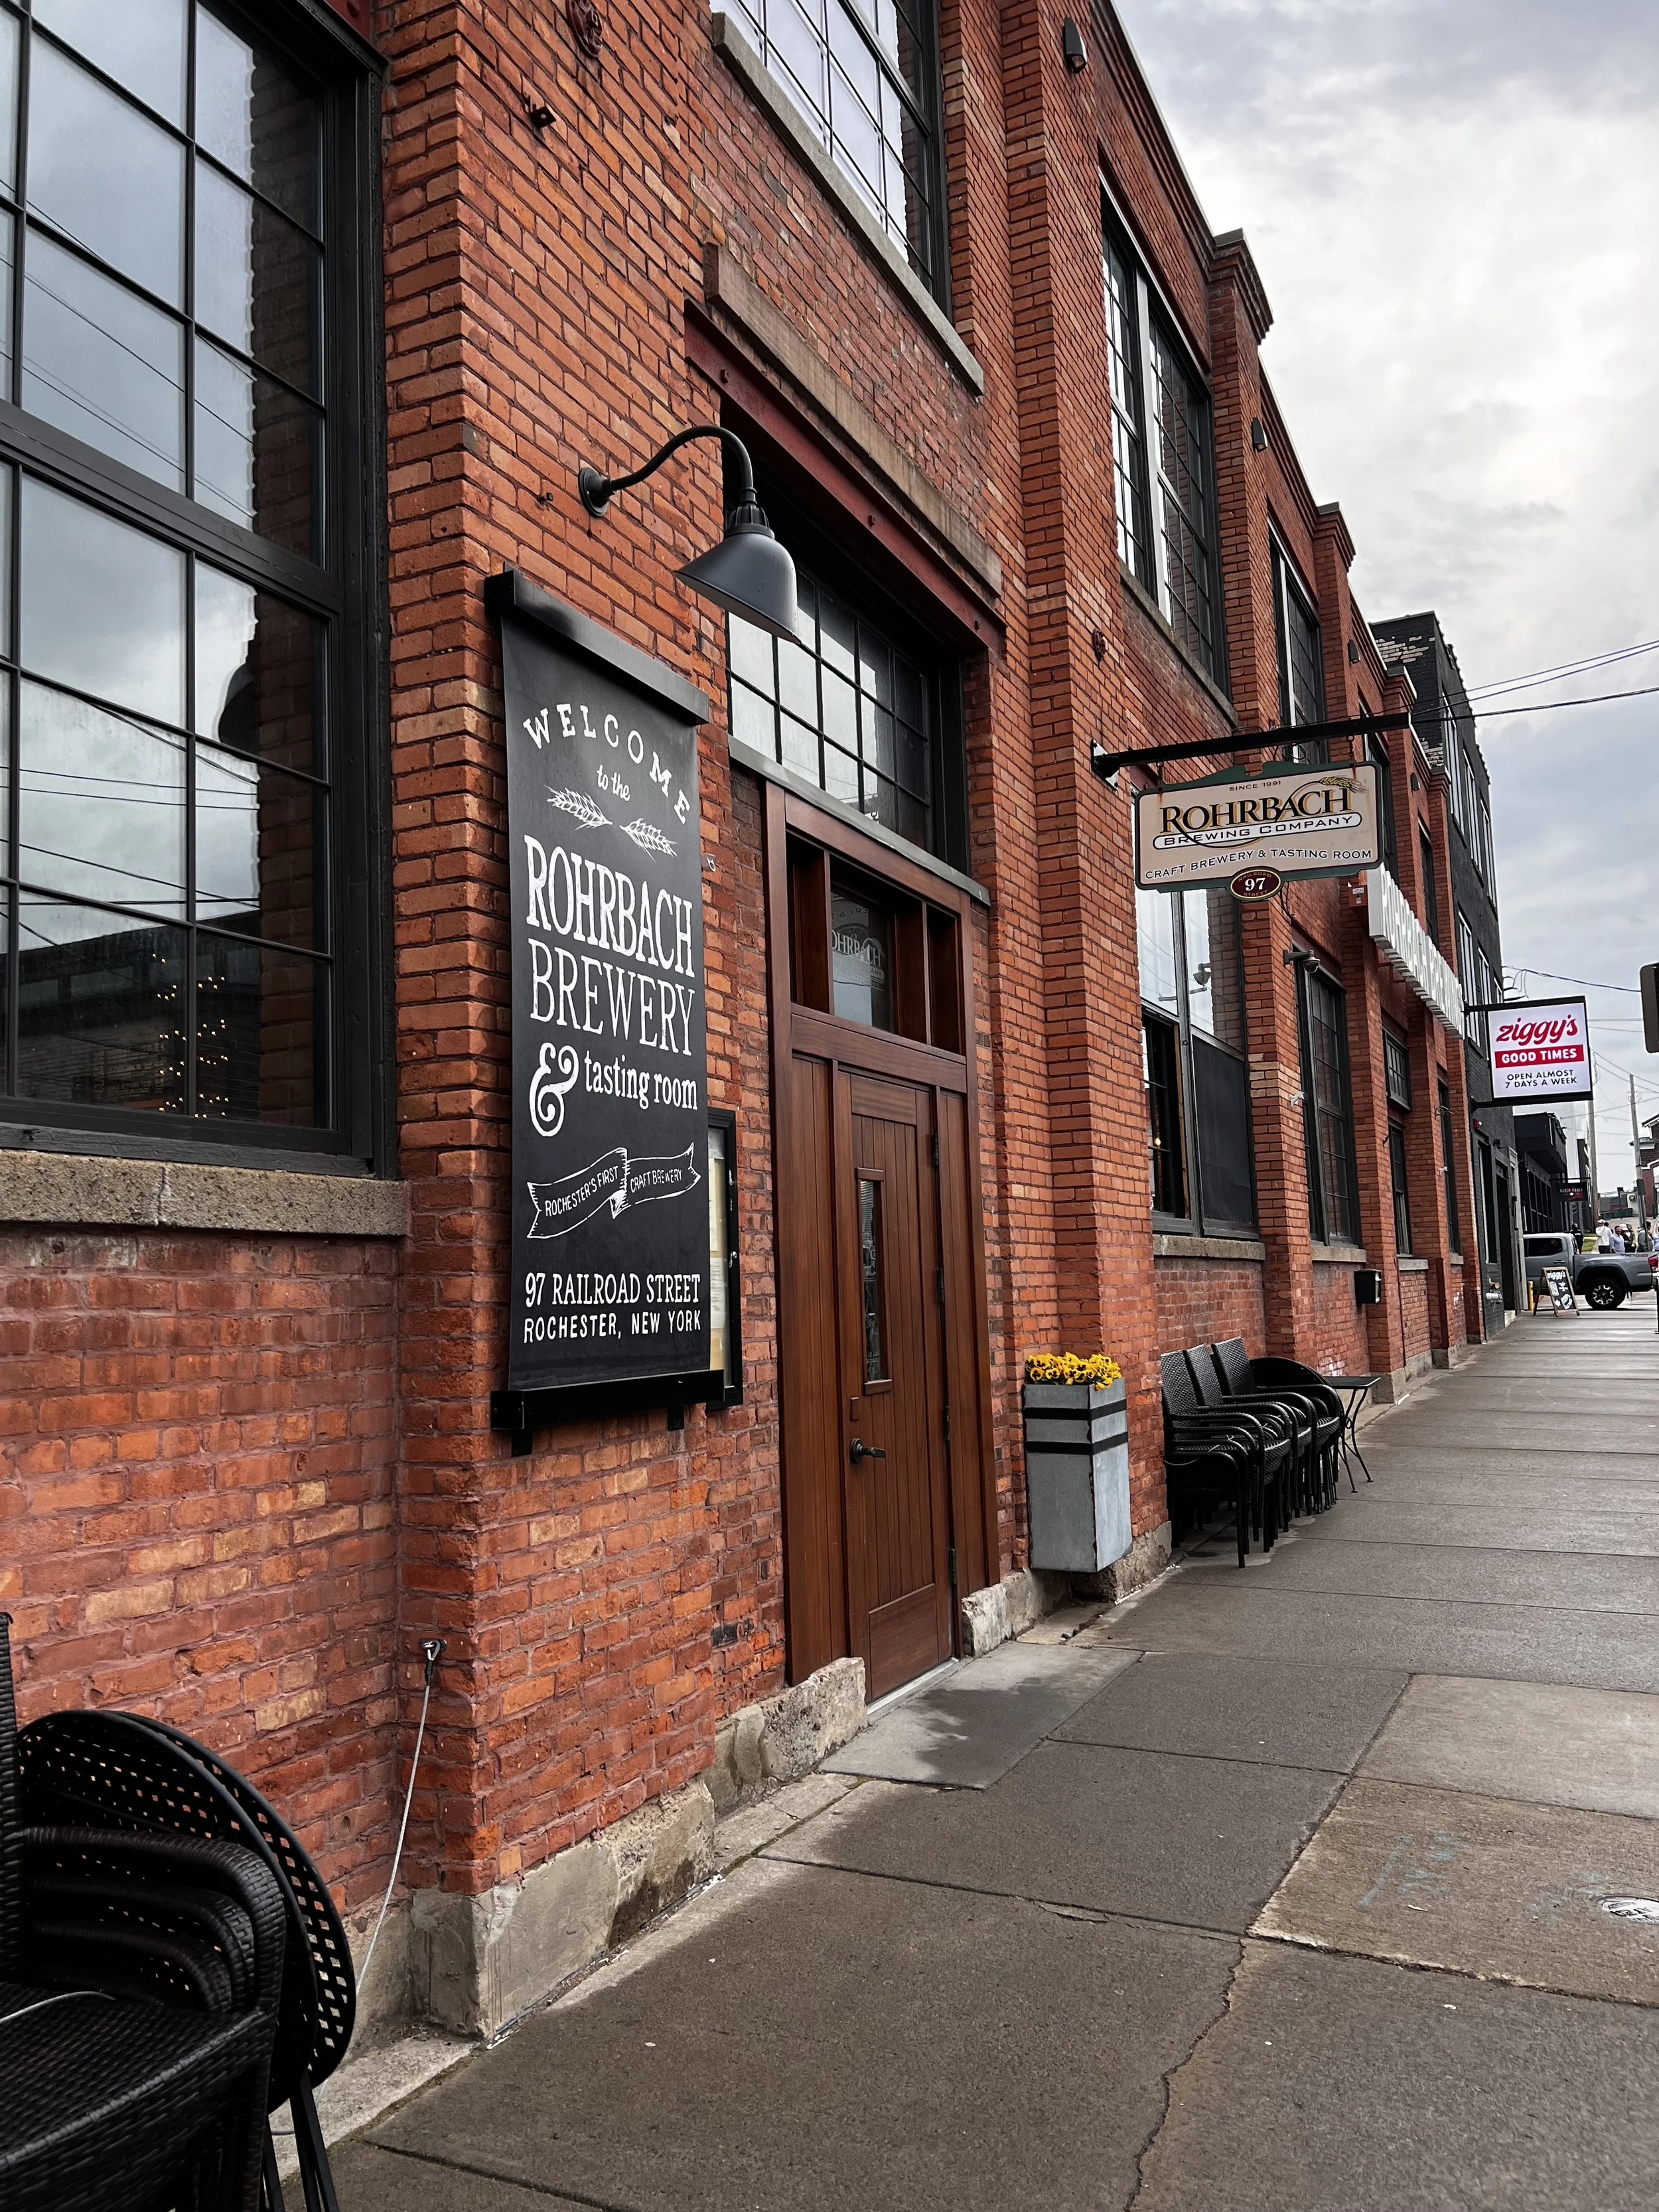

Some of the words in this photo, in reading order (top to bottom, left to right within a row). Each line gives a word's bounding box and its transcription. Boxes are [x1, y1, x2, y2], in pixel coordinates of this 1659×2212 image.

[523, 703, 691, 824] WELCOME
[597, 765, 609, 790] to
[611, 772, 630, 801] the
[1229, 783, 1258, 792] SINCE
[1159, 787, 1353, 835] ROHRBACH
[1164, 828, 1251, 846] BREWING
[1260, 815, 1353, 834] COMPANY
[1145, 864, 1185, 879] CRAFT
[1190, 850, 1253, 871] BREWERY
[1271, 849, 1328, 859] TASTING
[1333, 849, 1372, 859] ROOM
[1238, 871, 1272, 882] RAILROAD
[1245, 877, 1266, 891] 97
[524, 834, 695, 978] ROHRBACH
[528, 938, 695, 1056] BREWERY
[1496, 1014, 1579, 1046] ziggy's
[1502, 1051, 1537, 1064] GOOD
[1542, 1048, 1577, 1061] TIMES
[529, 1042, 579, 1137] &
[584, 1051, 650, 1109] tasting
[654, 1073, 698, 1110] room
[1507, 1072, 1532, 1081] OPEN
[1536, 1069, 1574, 1078] ALMOST
[545, 1179, 597, 1217] ROCHESTER'S
[597, 1165, 618, 1189] FIRST
[630, 1172, 651, 1193] CRAFT
[652, 1168, 682, 1185] BREWERY
[525, 1272, 546, 1307] 97
[552, 1273, 641, 1305] RAILROAD
[646, 1274, 701, 1303] STREET
[524, 1313, 622, 1345] ROCHESTER,
[632, 1311, 660, 1335] NEW
[668, 1309, 701, 1333] YORK
